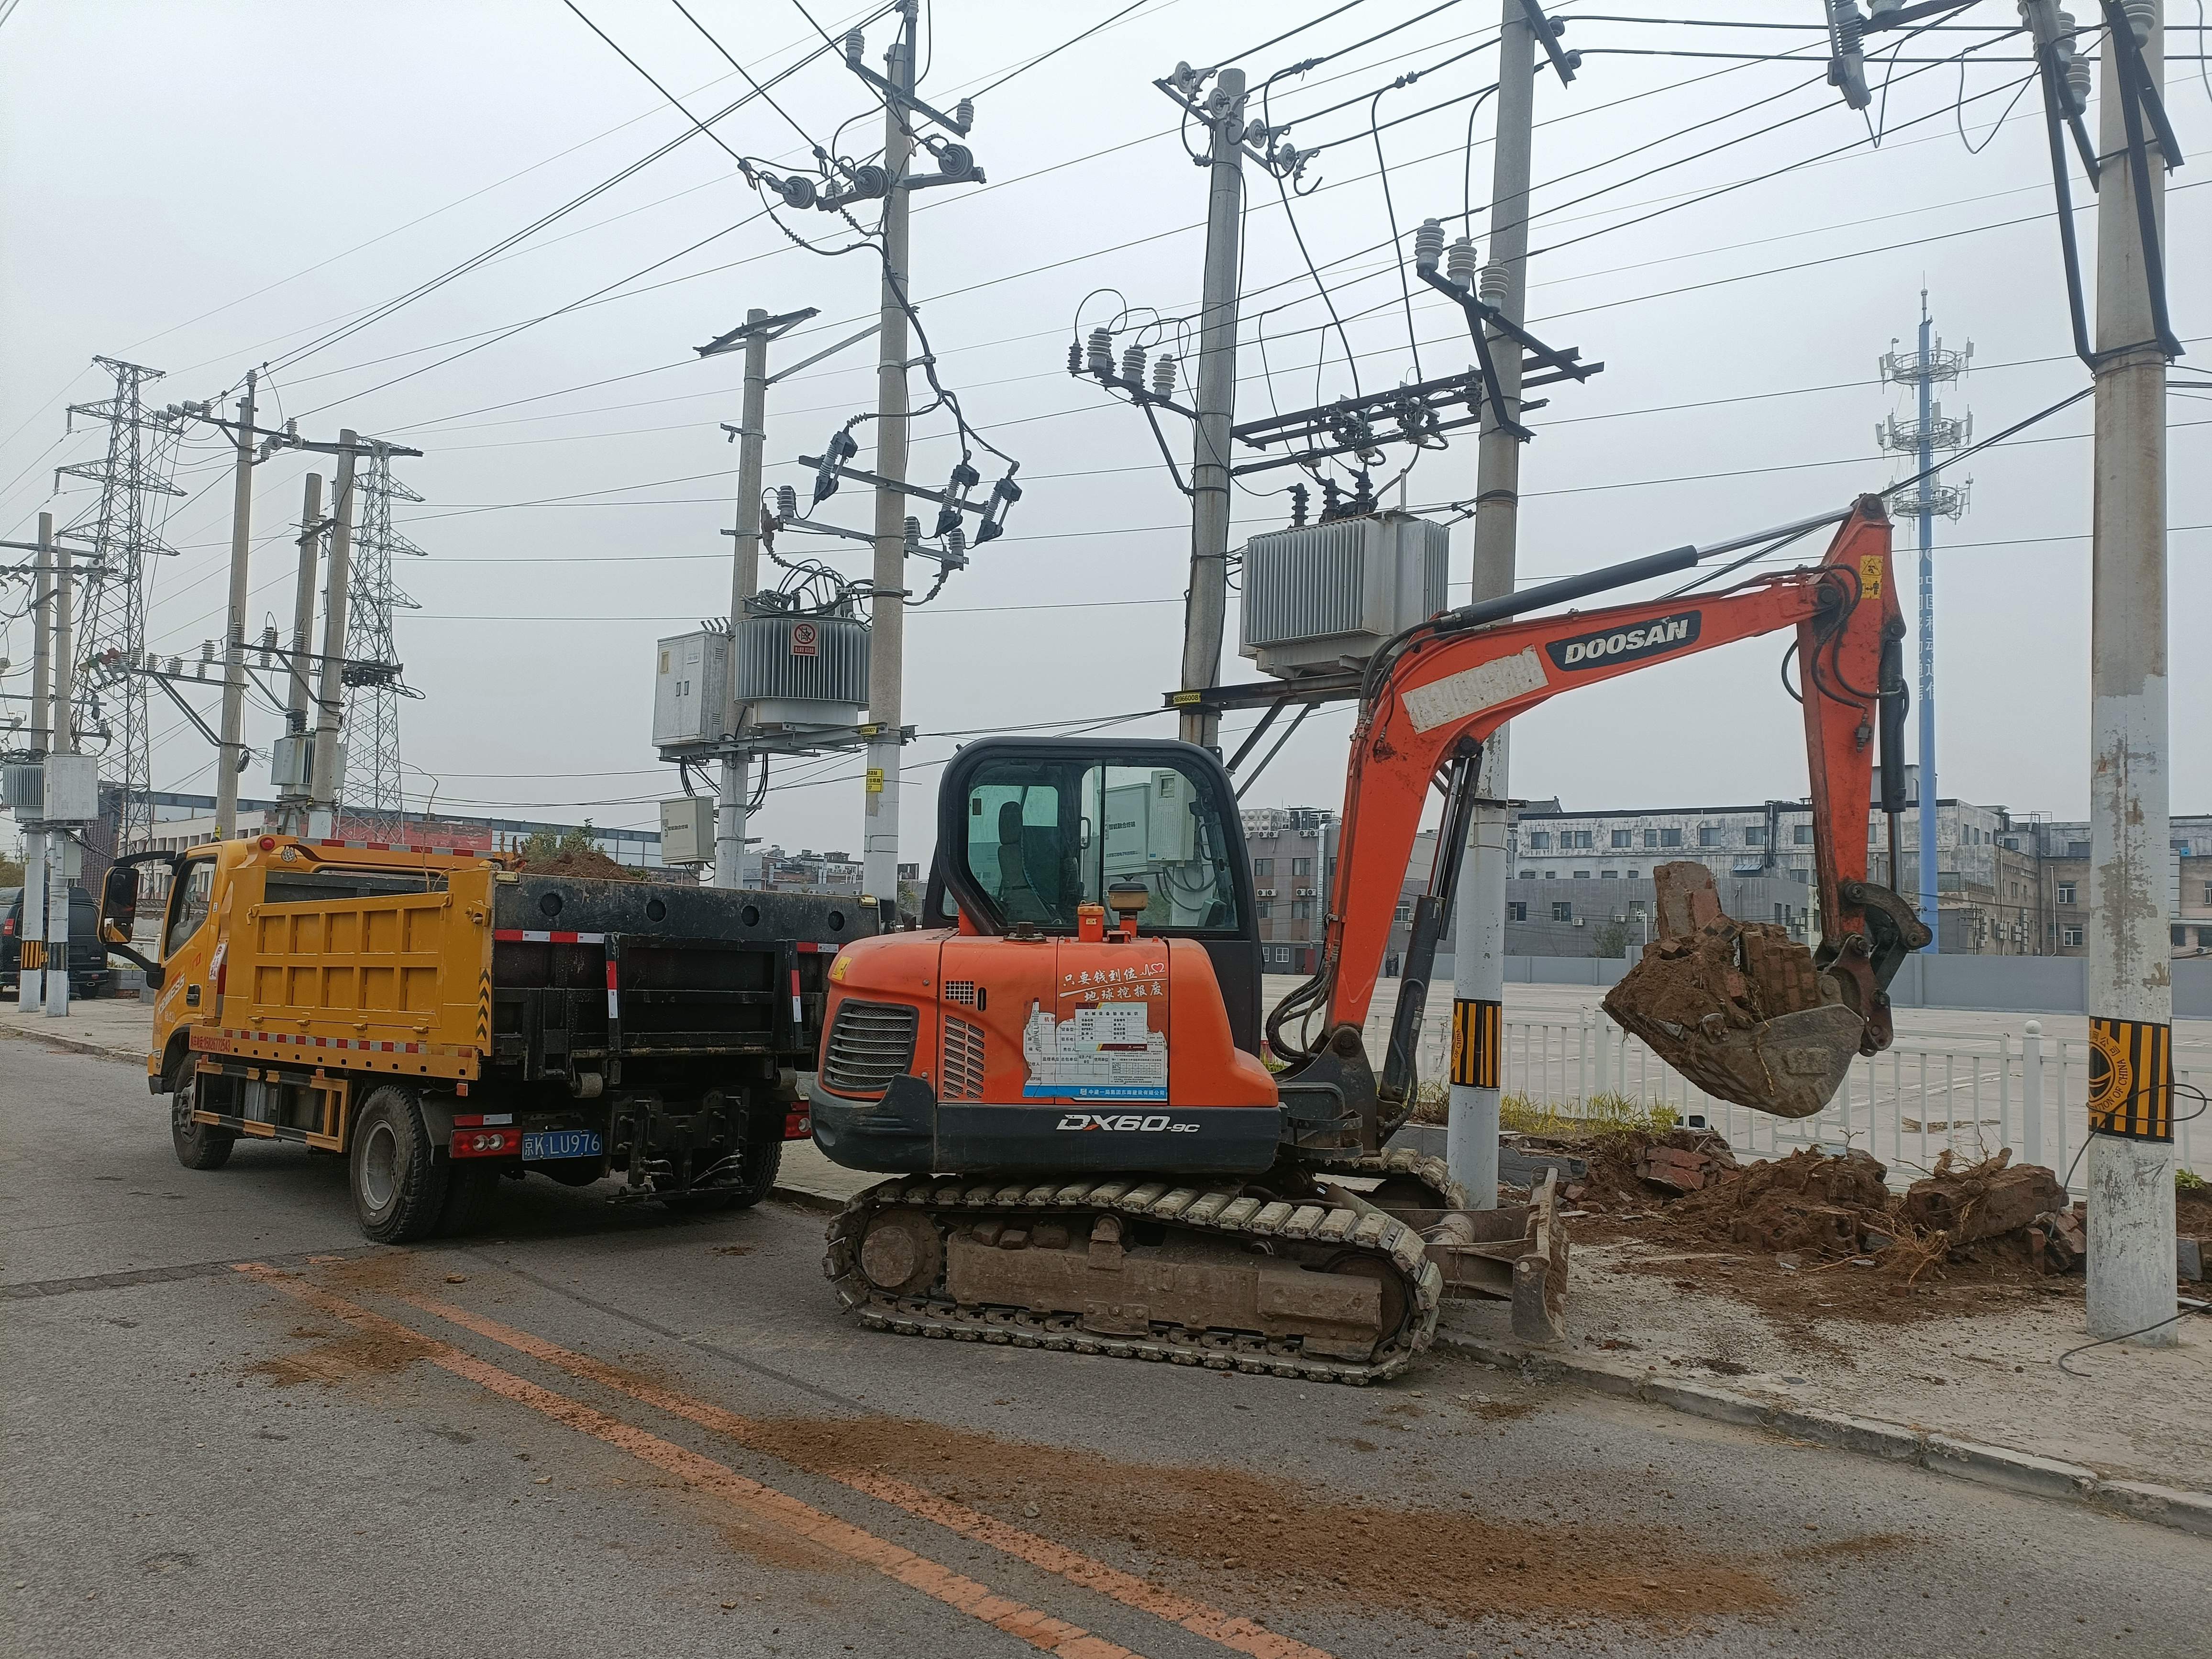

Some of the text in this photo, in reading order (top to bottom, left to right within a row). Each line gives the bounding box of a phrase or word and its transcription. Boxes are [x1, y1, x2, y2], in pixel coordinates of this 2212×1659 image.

[1564, 619, 1689, 664] DOOSAN
[1109, 821, 1136, 830] 智能融合终端
[1063, 967, 1138, 987] 只要钱到位
[1084, 981, 1163, 1002] 地球挖报废
[2117, 1058, 2128, 1086] CHINA
[2112, 1086, 2124, 1098] OF
